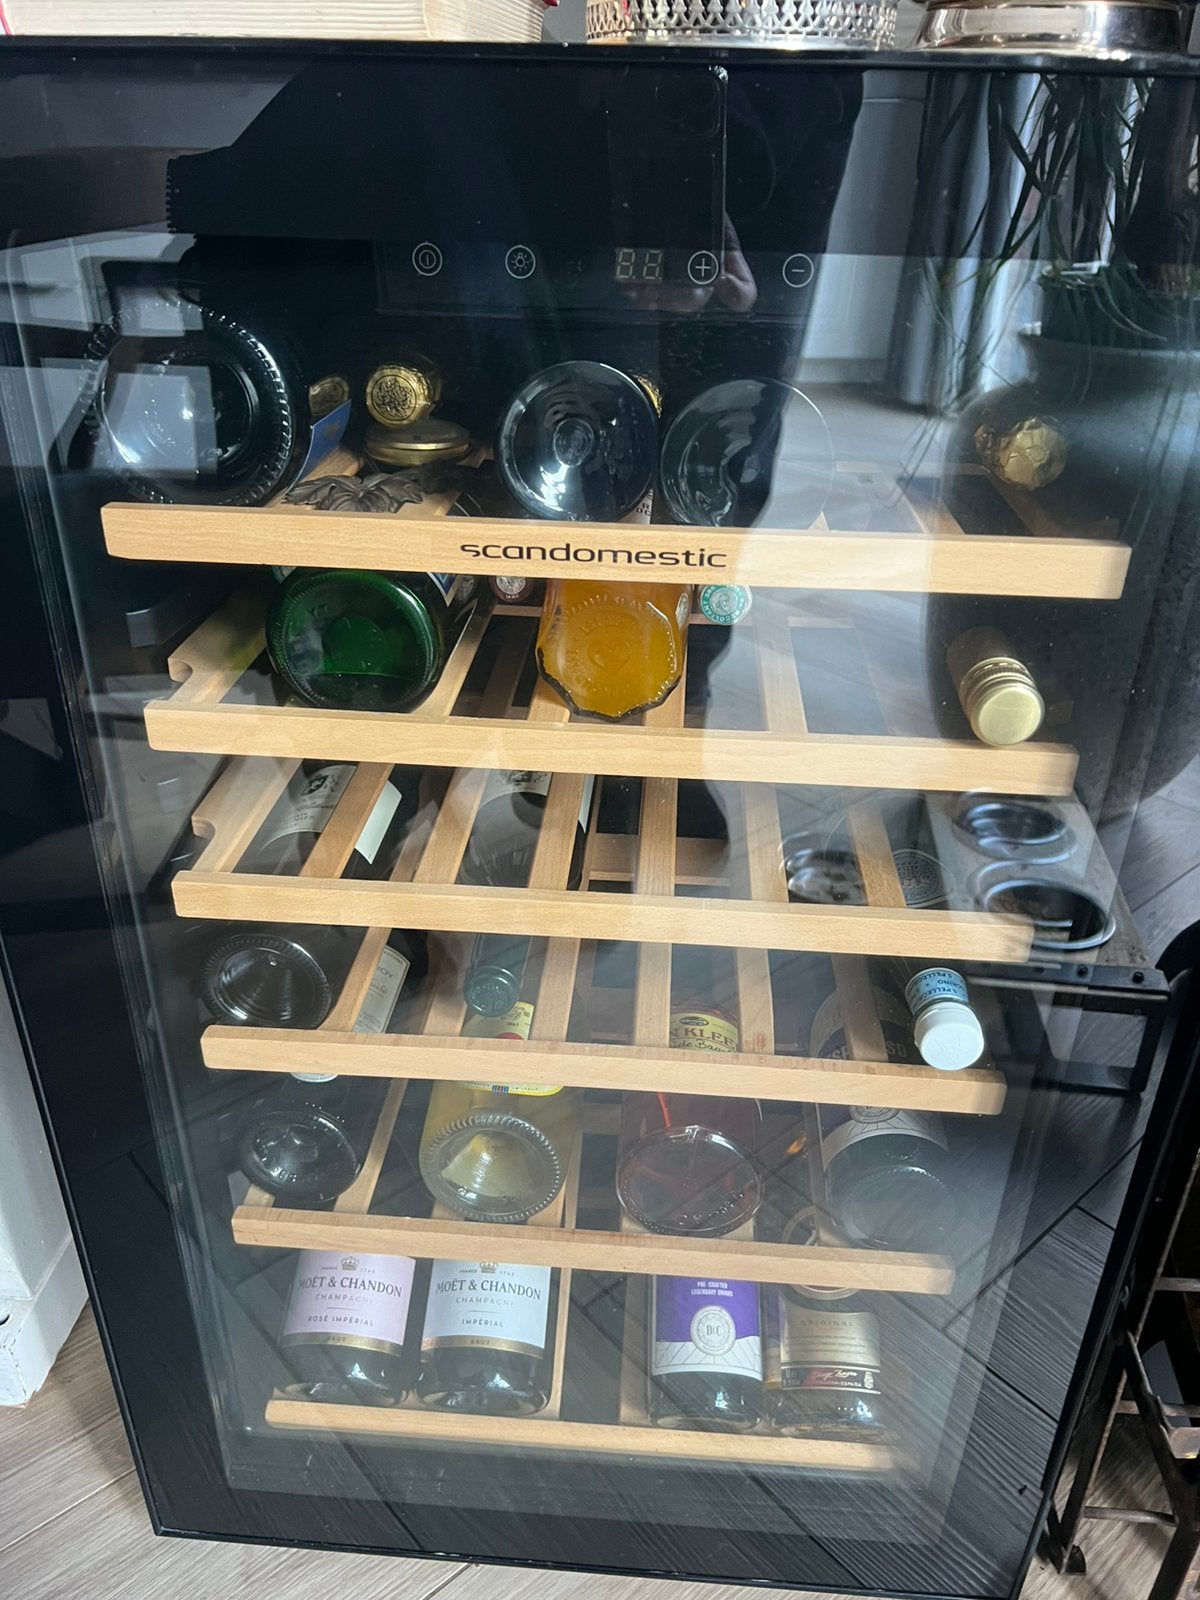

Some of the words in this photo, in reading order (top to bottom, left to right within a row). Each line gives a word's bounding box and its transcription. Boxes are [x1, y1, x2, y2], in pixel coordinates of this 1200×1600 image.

[459, 543, 728, 568] scandomestic
[299, 1274, 326, 1291] MOËT
[327, 1275, 338, 1289] &
[340, 1276, 403, 1298] CHANDON
[435, 1278, 466, 1295] MOËT
[467, 1278, 478, 1291] &
[480, 1279, 541, 1301] CHANDON
[308, 1314, 329, 1323] ROSÉ
[331, 1315, 375, 1328] IMPÉRIAL
[461, 1317, 504, 1329] IMPÉRIAL
